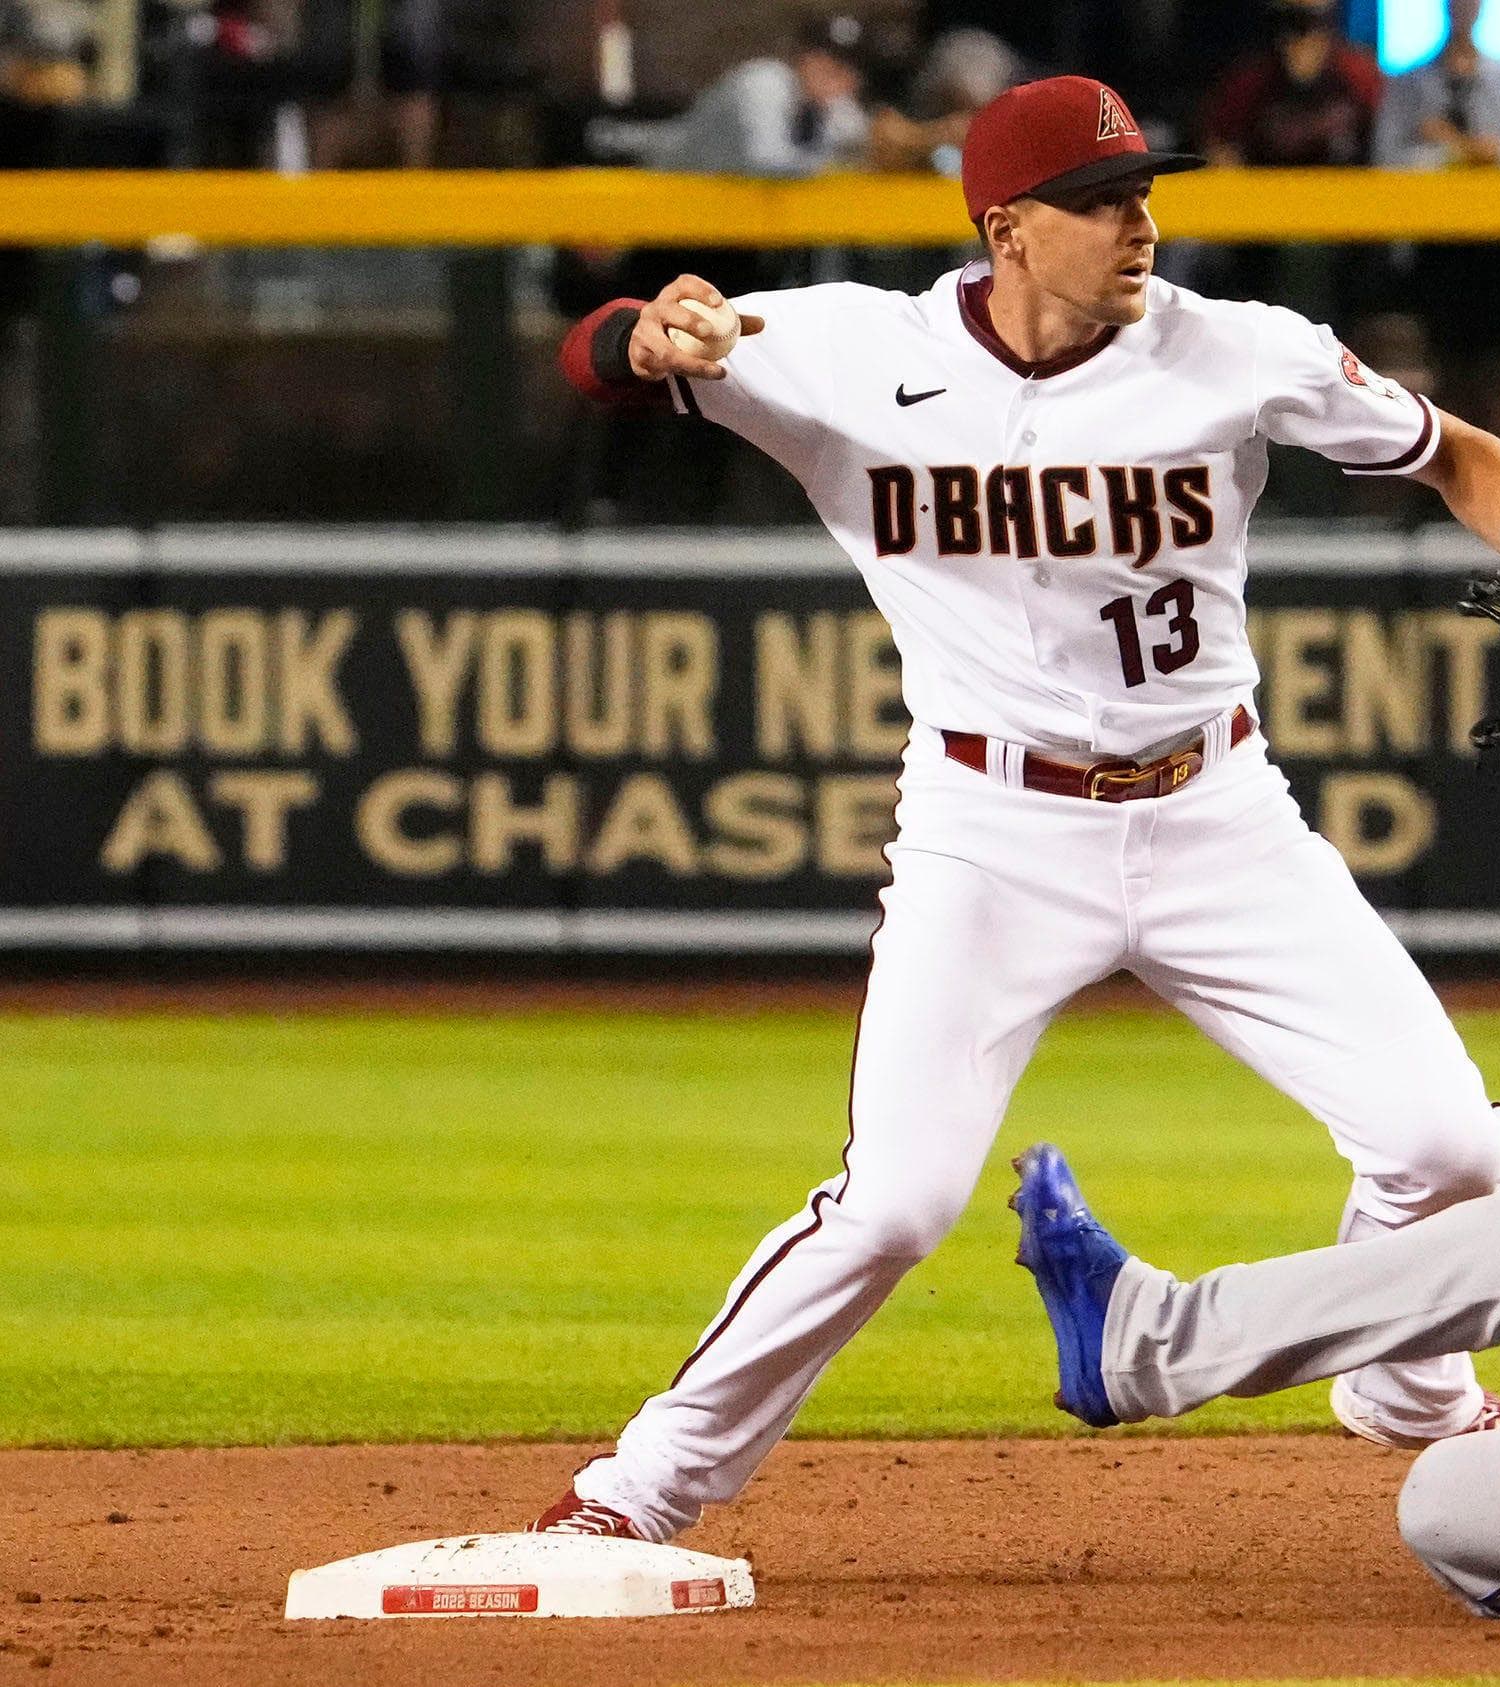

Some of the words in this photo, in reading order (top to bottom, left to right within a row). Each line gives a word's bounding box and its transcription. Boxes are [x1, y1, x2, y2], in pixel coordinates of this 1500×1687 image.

[33, 607, 358, 757] BOOK
[396, 607, 717, 758] YOUR
[1099, 577, 1200, 689] 13
[101, 770, 321, 872] AT
[355, 767, 900, 878] CHASE
[432, 1594, 465, 1610] 2022
[469, 1592, 520, 1610] SEASON
